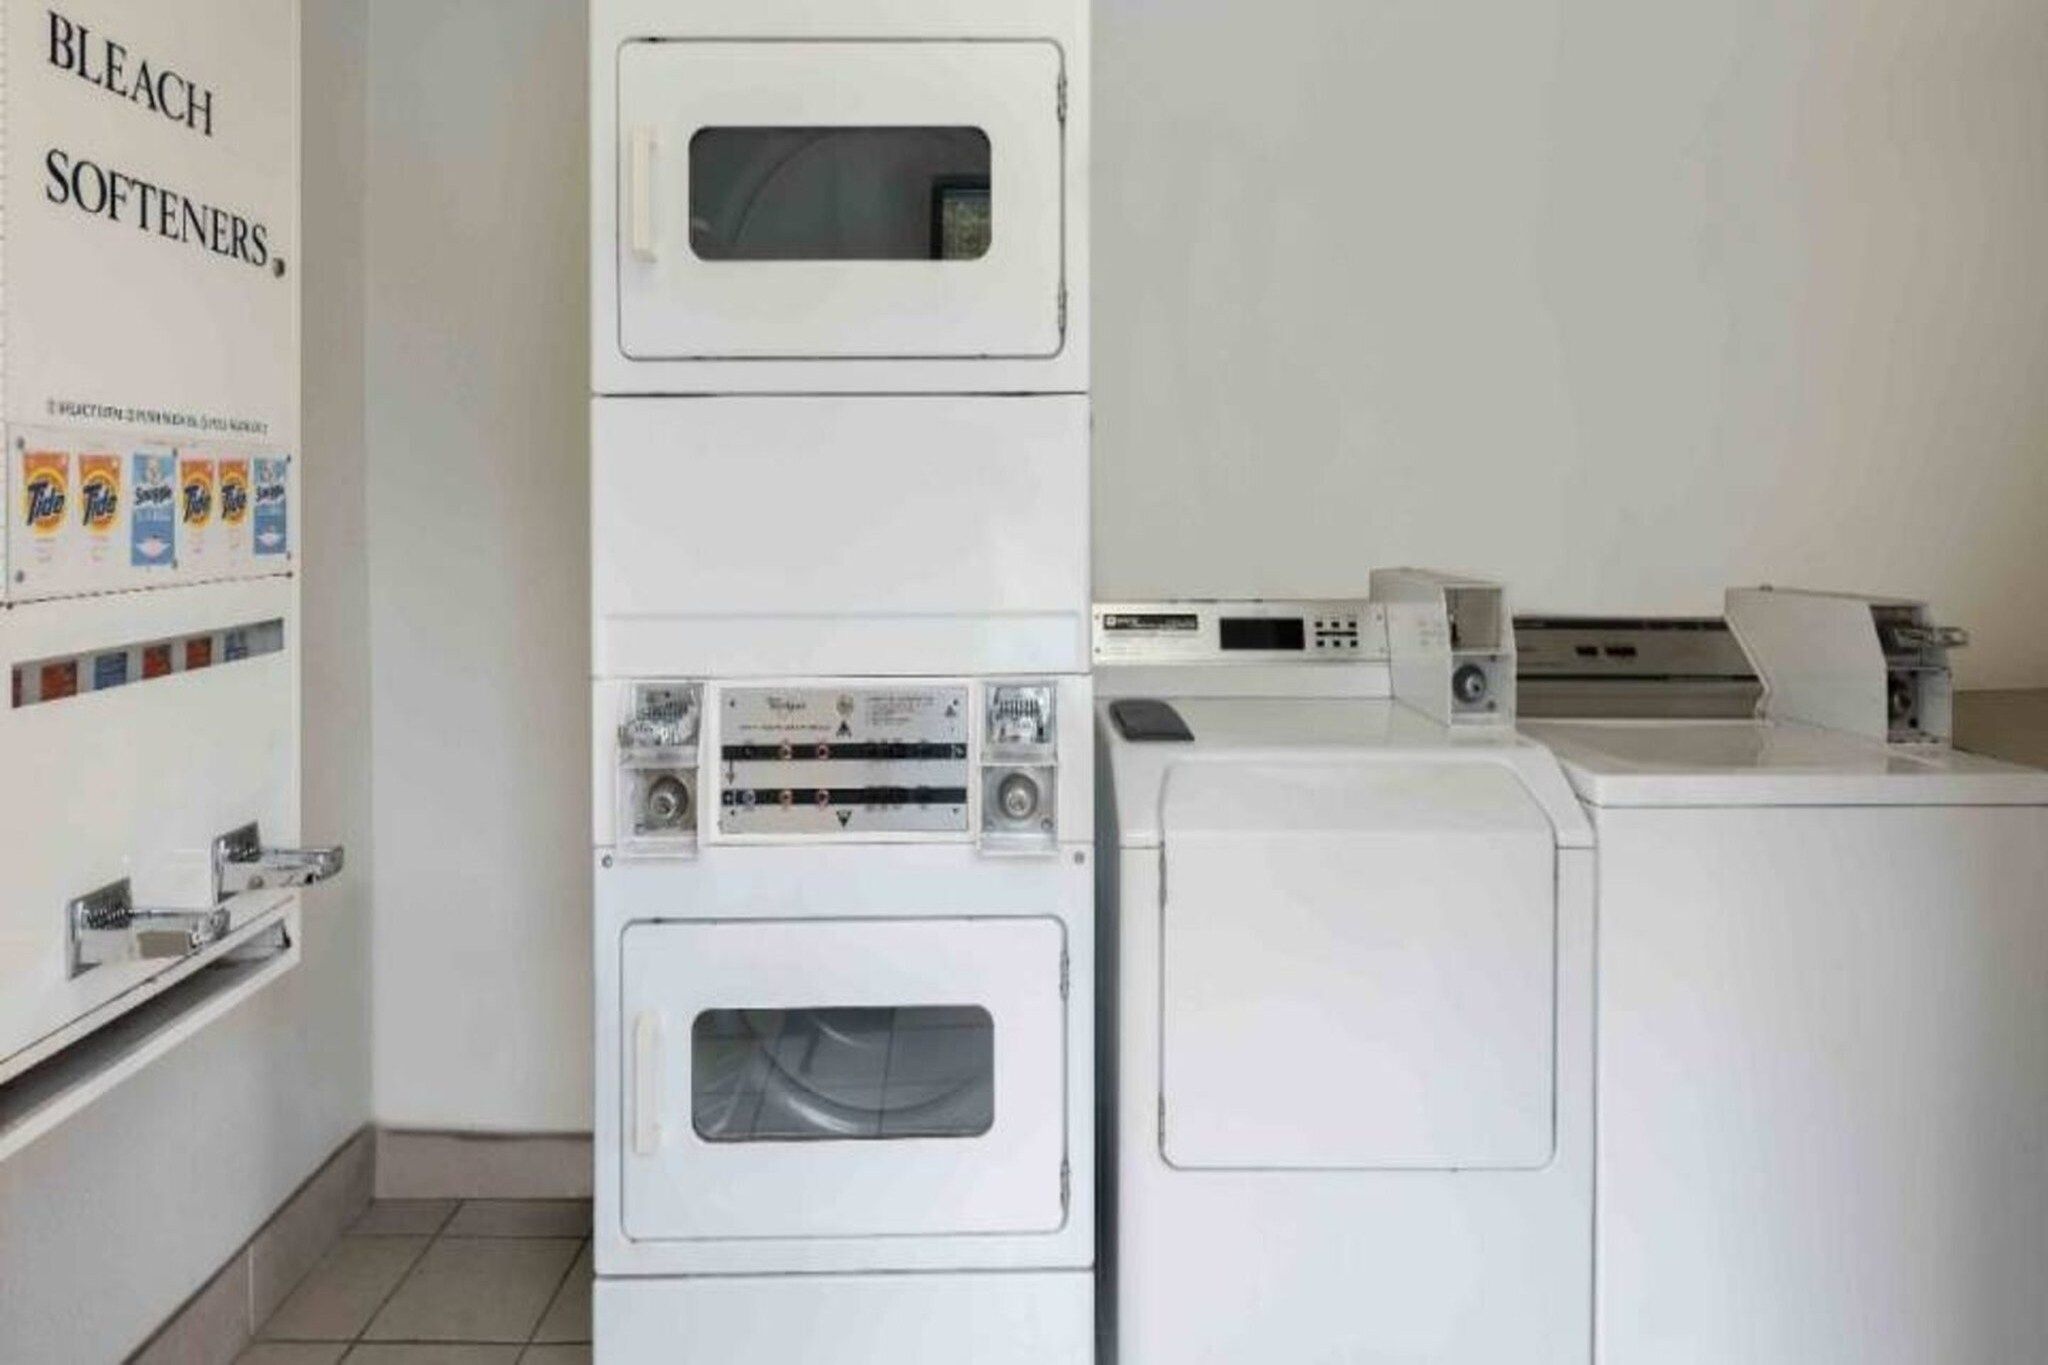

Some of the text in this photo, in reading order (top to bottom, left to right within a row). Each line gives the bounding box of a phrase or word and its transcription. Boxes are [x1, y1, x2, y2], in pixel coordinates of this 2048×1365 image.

[48, 10, 212, 137] BLEACH
[46, 149, 268, 266] SOFTENERS
[27, 482, 65, 526] Tide
[82, 484, 118, 526] Tide
[183, 485, 212, 523] Tide
